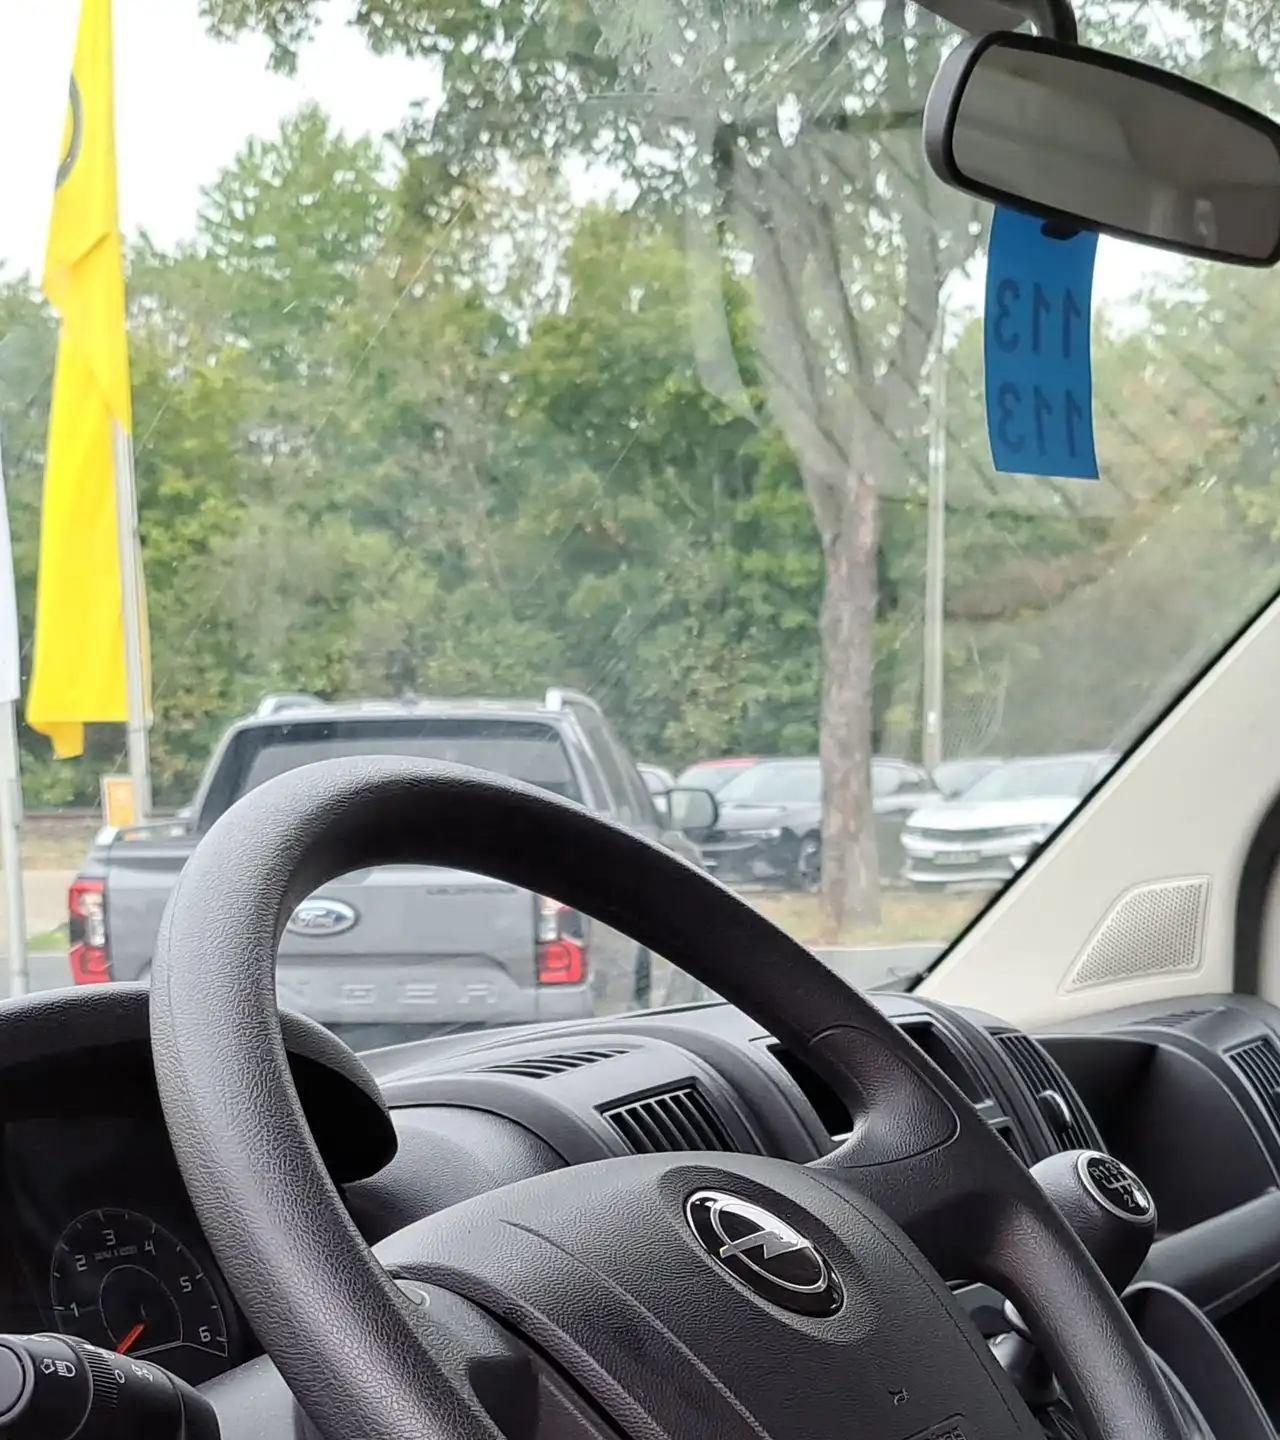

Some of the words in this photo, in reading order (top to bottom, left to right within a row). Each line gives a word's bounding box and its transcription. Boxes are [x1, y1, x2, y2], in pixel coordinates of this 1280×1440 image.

[102, 1229, 116, 1246] 3
[144, 1240, 156, 1256] 4
[74, 1254, 88, 1271] 2
[180, 1276, 192, 1293] 5
[199, 1326, 211, 1342] 6
